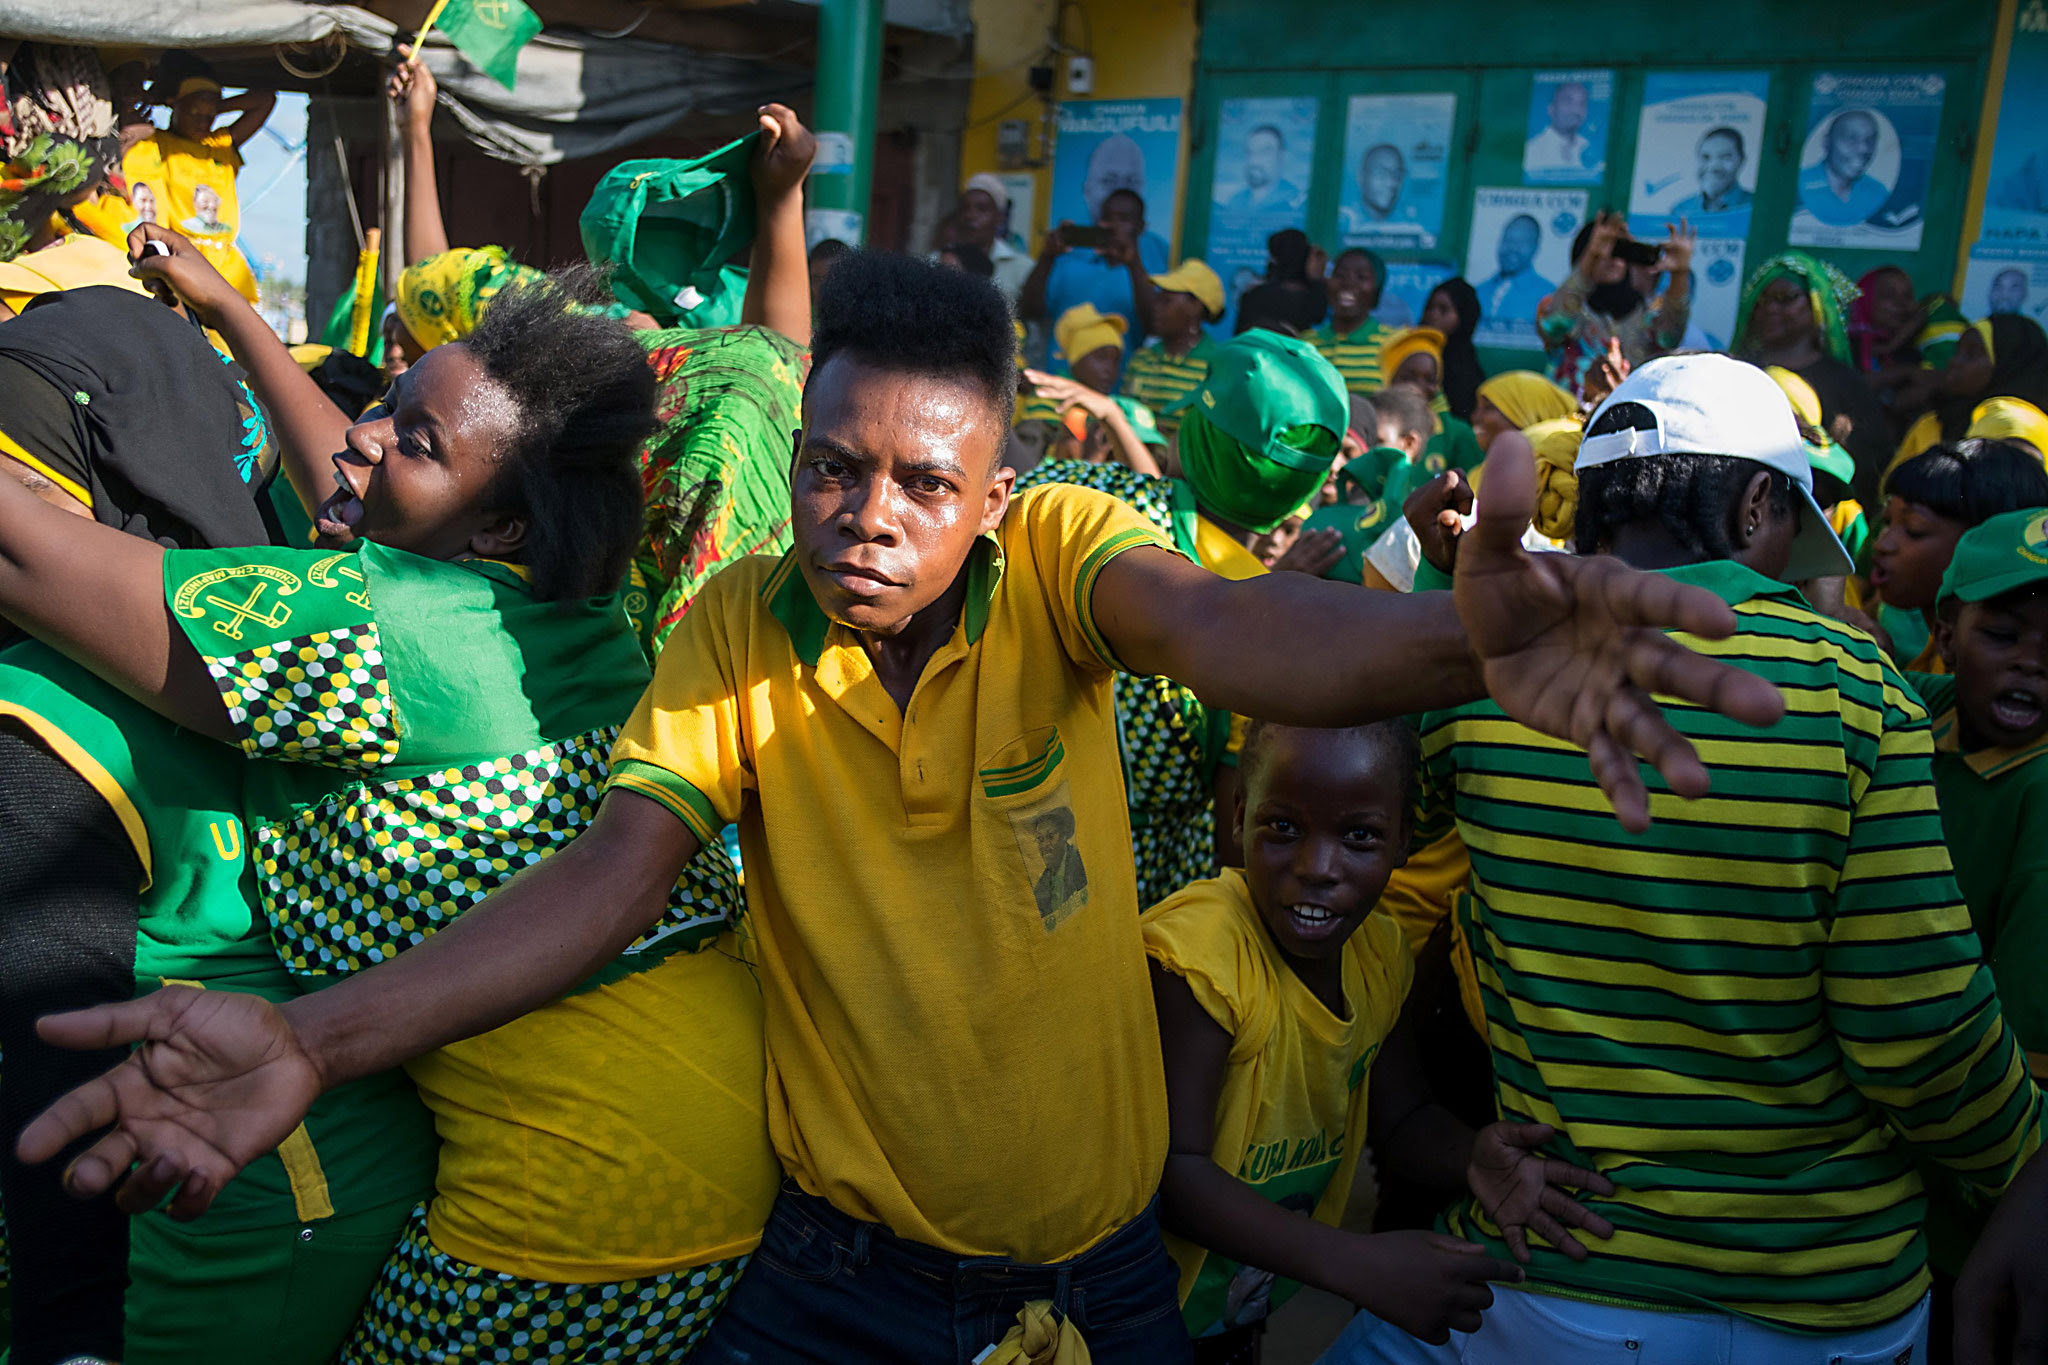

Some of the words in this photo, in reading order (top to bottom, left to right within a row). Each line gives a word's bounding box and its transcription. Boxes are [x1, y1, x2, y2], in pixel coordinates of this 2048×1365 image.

[228, 566, 255, 577] CHA
[257, 566, 297, 585] CHAMA
[178, 569, 227, 610] MAPINDUZI
[210, 820, 240, 860] U
